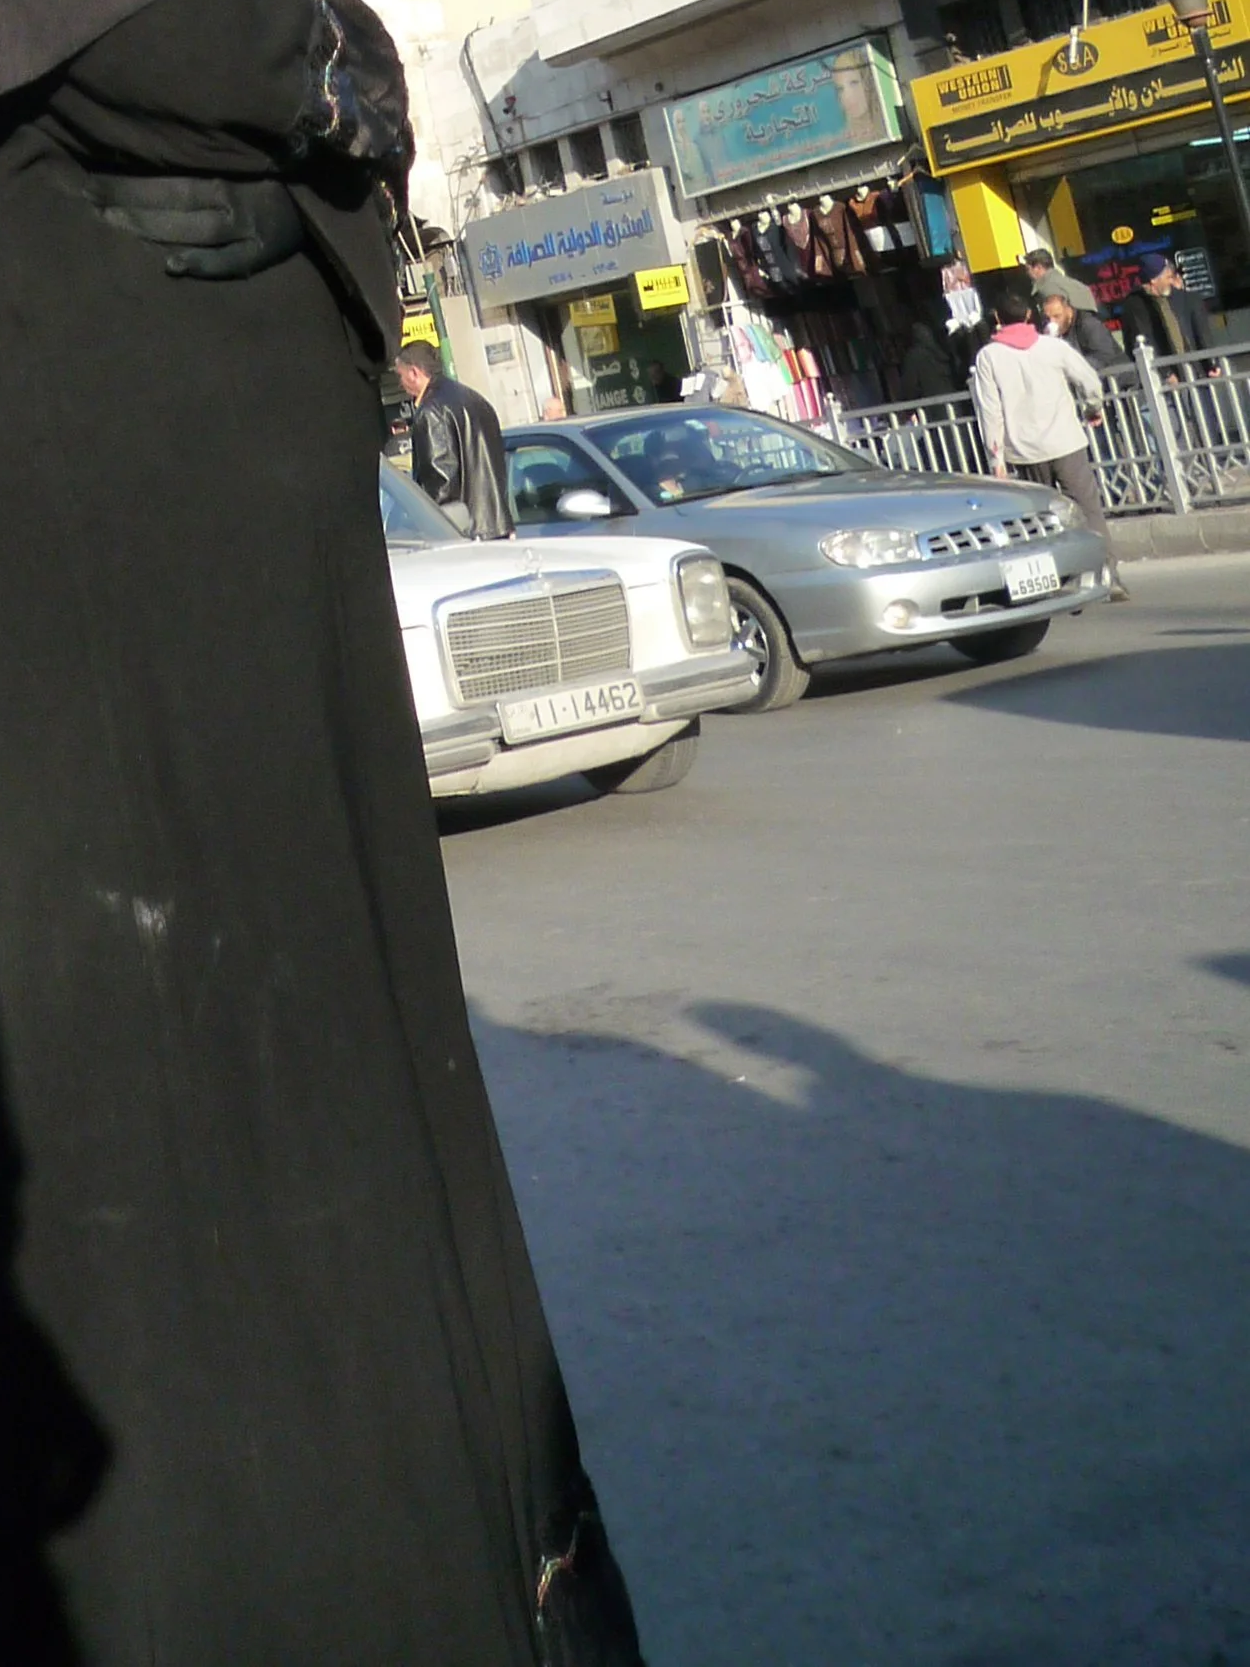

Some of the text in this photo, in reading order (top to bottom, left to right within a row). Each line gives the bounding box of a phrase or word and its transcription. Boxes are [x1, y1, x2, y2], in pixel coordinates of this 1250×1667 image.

[938, 67, 998, 94] WESTERN
[958, 80, 1000, 100] UNION
[743, 104, 817, 145] التجارية
[506, 207, 654, 268] المشرق الدولية للصرافة
[1018, 573, 1058, 595] 69506
